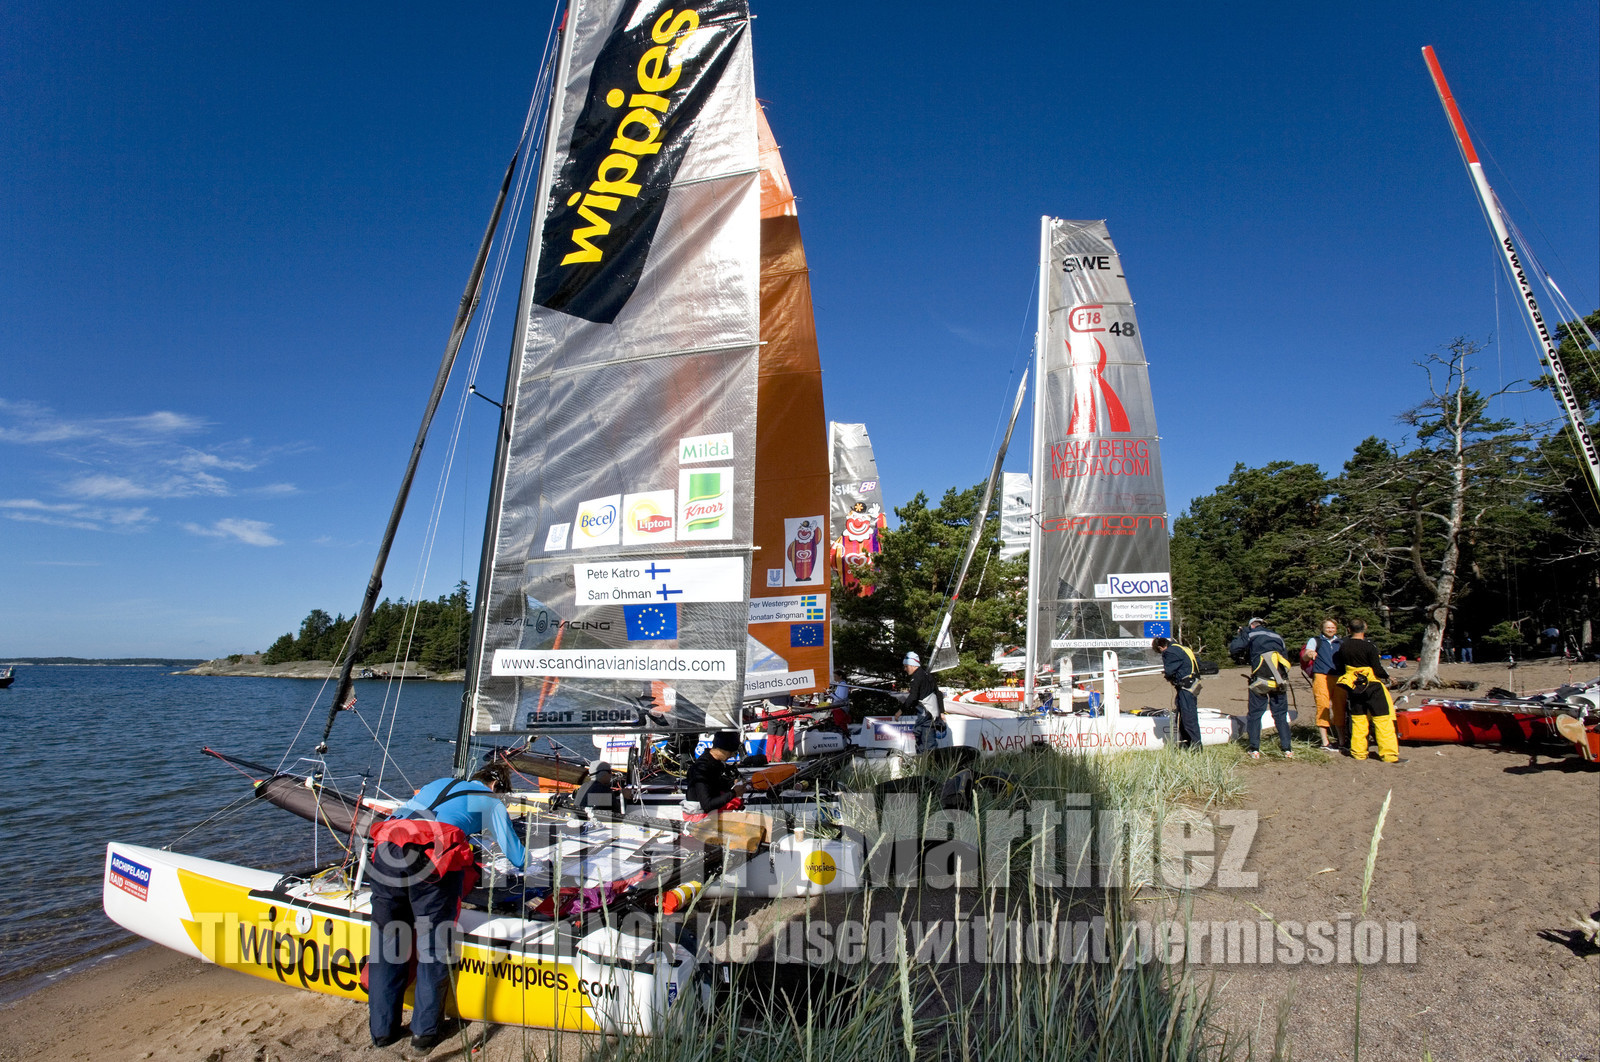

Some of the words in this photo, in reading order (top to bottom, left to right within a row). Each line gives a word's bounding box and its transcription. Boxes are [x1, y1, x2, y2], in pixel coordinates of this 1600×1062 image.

[559, 8, 700, 267] wippies
[1062, 256, 1111, 272] SWE
[1077, 311, 1102, 325] F18
[1109, 322, 1136, 337] 48
[1502, 237, 1600, 467] www.team-ocean.com
[682, 440, 730, 460] Milda
[1051, 440, 1149, 463] KARLBERG
[1052, 458, 1150, 481] MEDIA.COM
[834, 483, 857, 496] SWE
[859, 481, 877, 494] 88
[580, 510, 613, 528] Becel
[685, 502, 725, 520] Knorr
[639, 518, 671, 531] Lipton
[1042, 515, 1165, 533] capricorn
[587, 568, 608, 580] Pete
[611, 567, 640, 579] Katro
[1109, 576, 1169, 595] Rexona
[587, 589, 610, 601] Sam
[612, 587, 652, 600] Öhman
[749, 601, 761, 609] Per
[761, 600, 799, 609] Westergren
[503, 617, 534, 628] SAIL
[549, 620, 612, 631] RACING
[748, 613, 774, 622] Jonatan
[775, 611, 805, 621] Singman
[501, 655, 726, 673] www.scandinavianislands.com
[993, 691, 1019, 699] YAMAHA
[111, 857, 150, 882] ARCHIPELAGO
[110, 872, 124, 888] RAID
